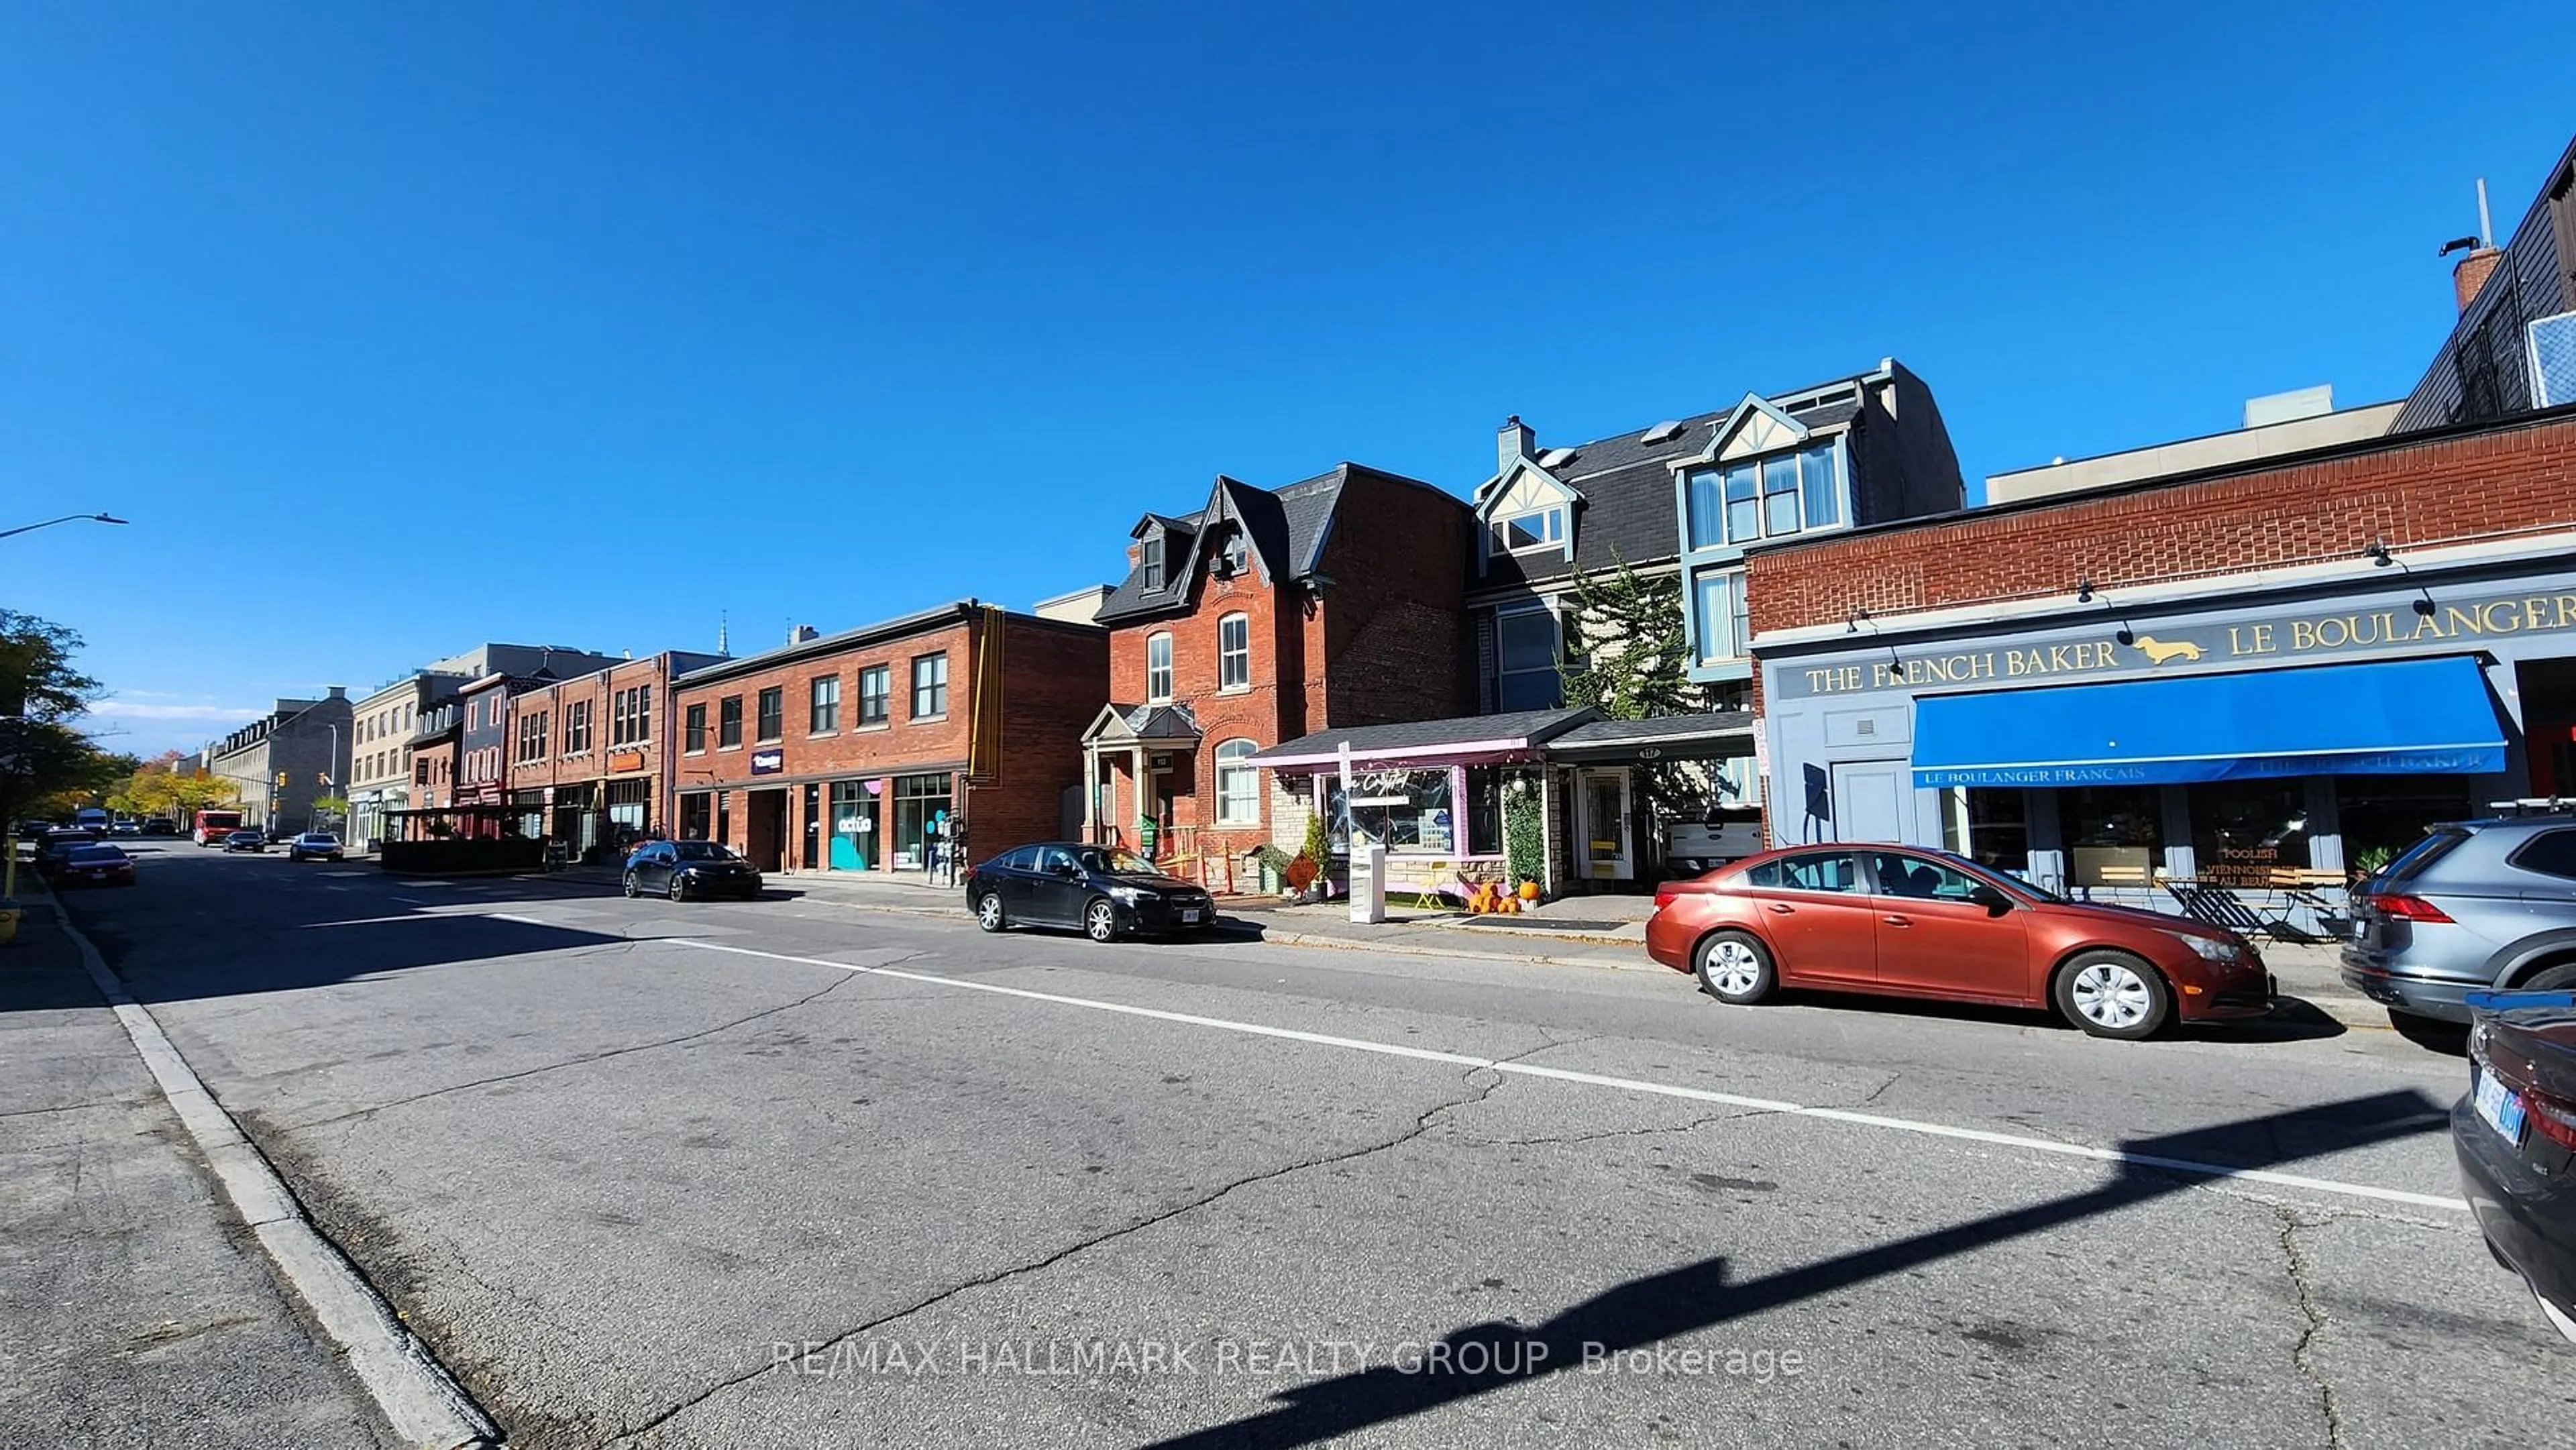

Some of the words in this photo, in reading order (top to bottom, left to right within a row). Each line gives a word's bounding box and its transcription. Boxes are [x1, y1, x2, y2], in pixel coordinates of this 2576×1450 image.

[2229, 624, 2277, 656] LE
[2291, 595, 2576, 650] BOULANGER
[1806, 666, 1864, 693] THE
[1872, 653, 1995, 687] FRENCH
[2005, 641, 2119, 676] BAKER
[1925, 773, 1944, 784] LE
[1947, 771, 2050, 783] BOULANGER
